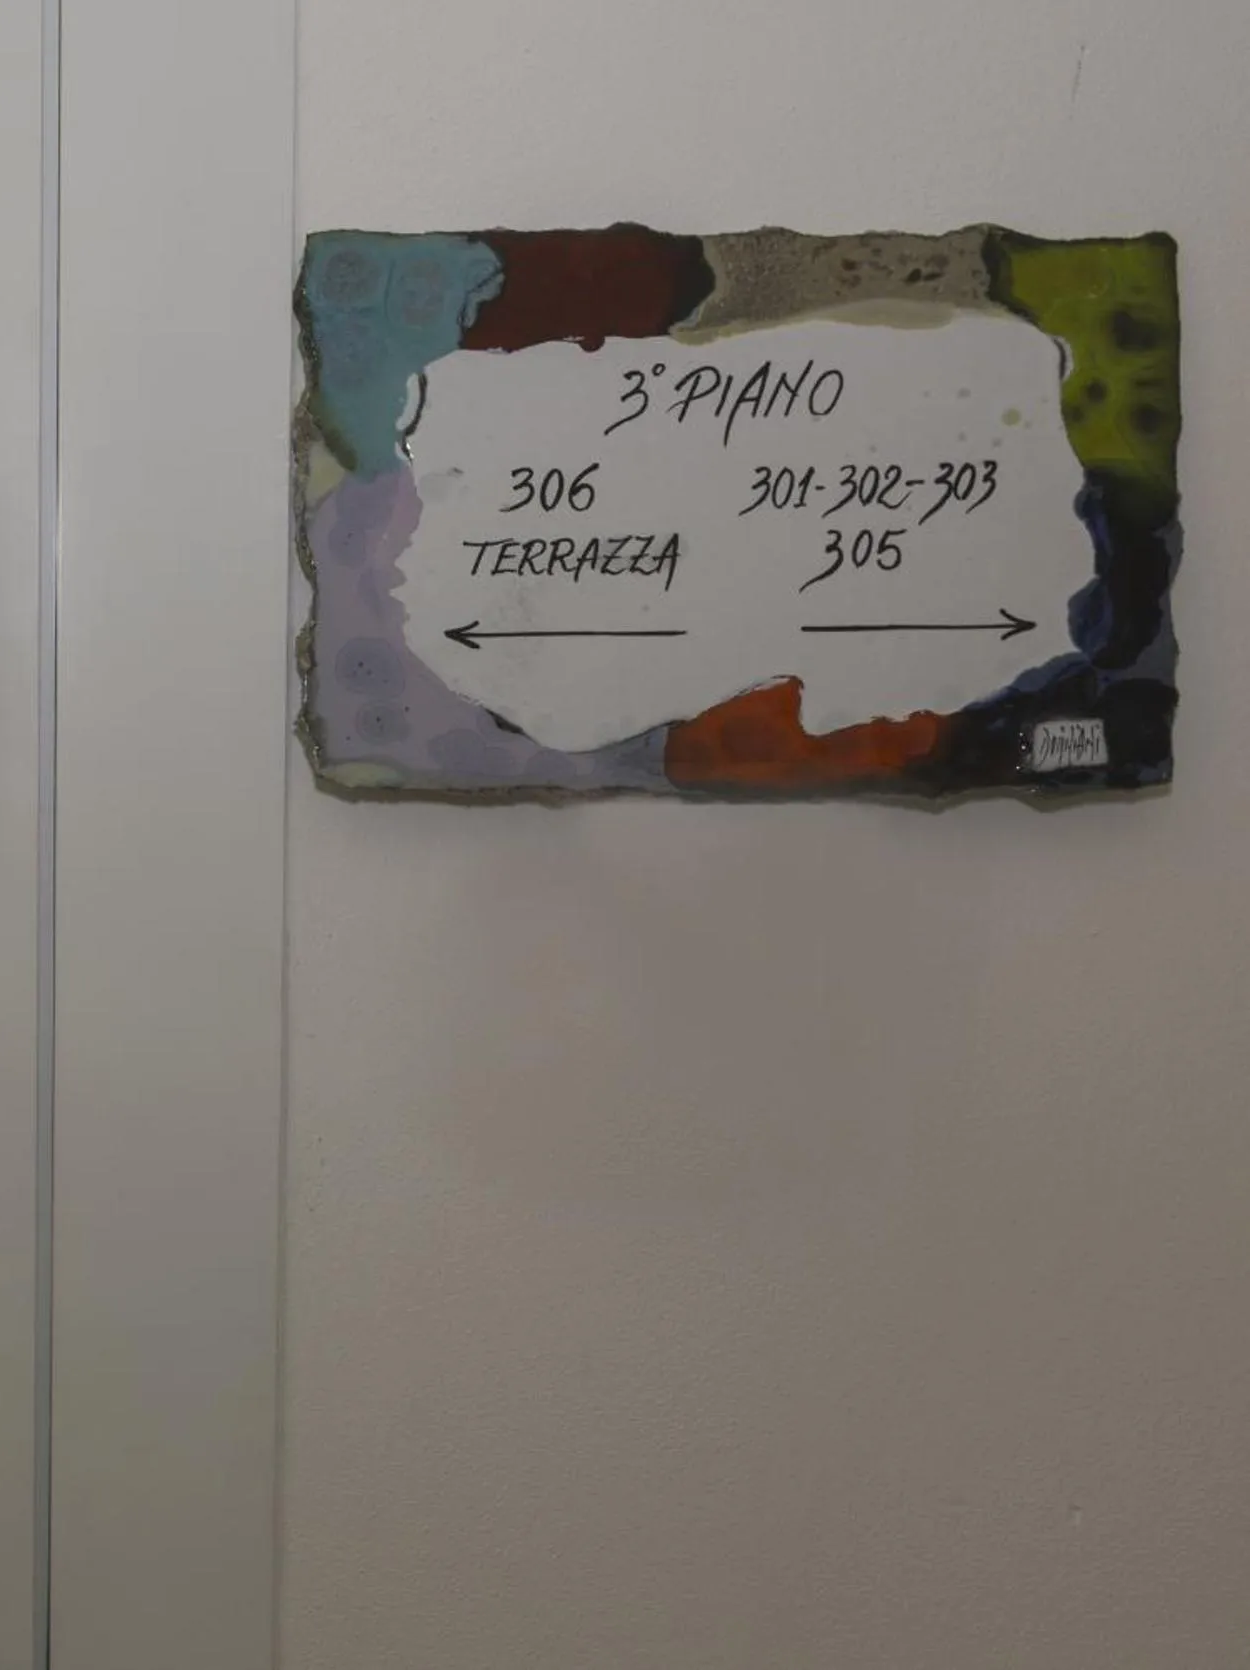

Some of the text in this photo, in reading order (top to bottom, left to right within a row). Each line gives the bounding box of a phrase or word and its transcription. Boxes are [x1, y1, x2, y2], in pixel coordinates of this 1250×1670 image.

[667, 358, 846, 450] PIANO
[498, 461, 601, 514] 306
[737, 458, 1000, 527] 301-302-303
[461, 531, 683, 593] TERRAZZA
[798, 527, 909, 594] 305
